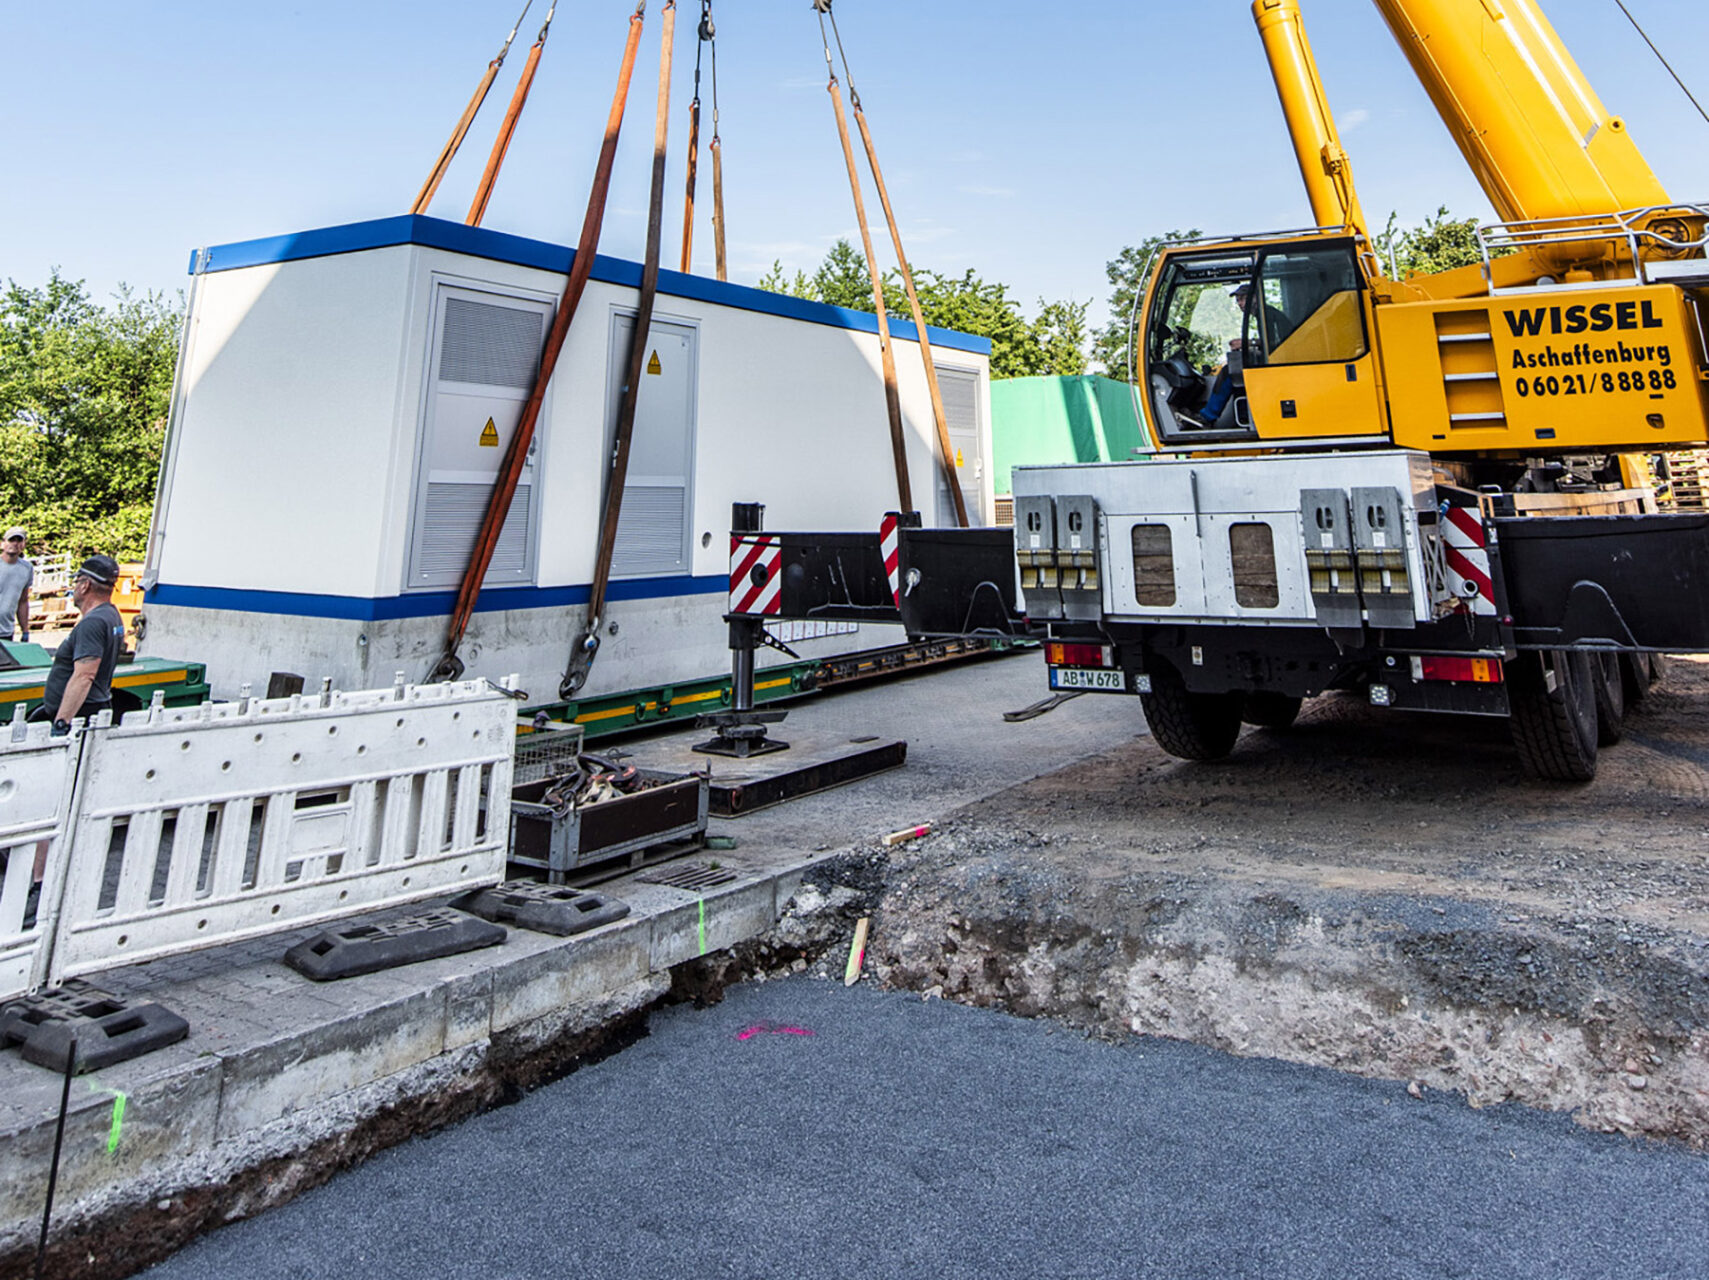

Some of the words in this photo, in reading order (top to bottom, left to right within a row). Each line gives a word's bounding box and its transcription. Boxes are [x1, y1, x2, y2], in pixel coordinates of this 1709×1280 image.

[1503, 300, 1663, 337] WISSEL
[1512, 341, 1671, 369] Aschaffenburg
[1062, 671, 1078, 686] AB
[1096, 672, 1120, 687] 678
